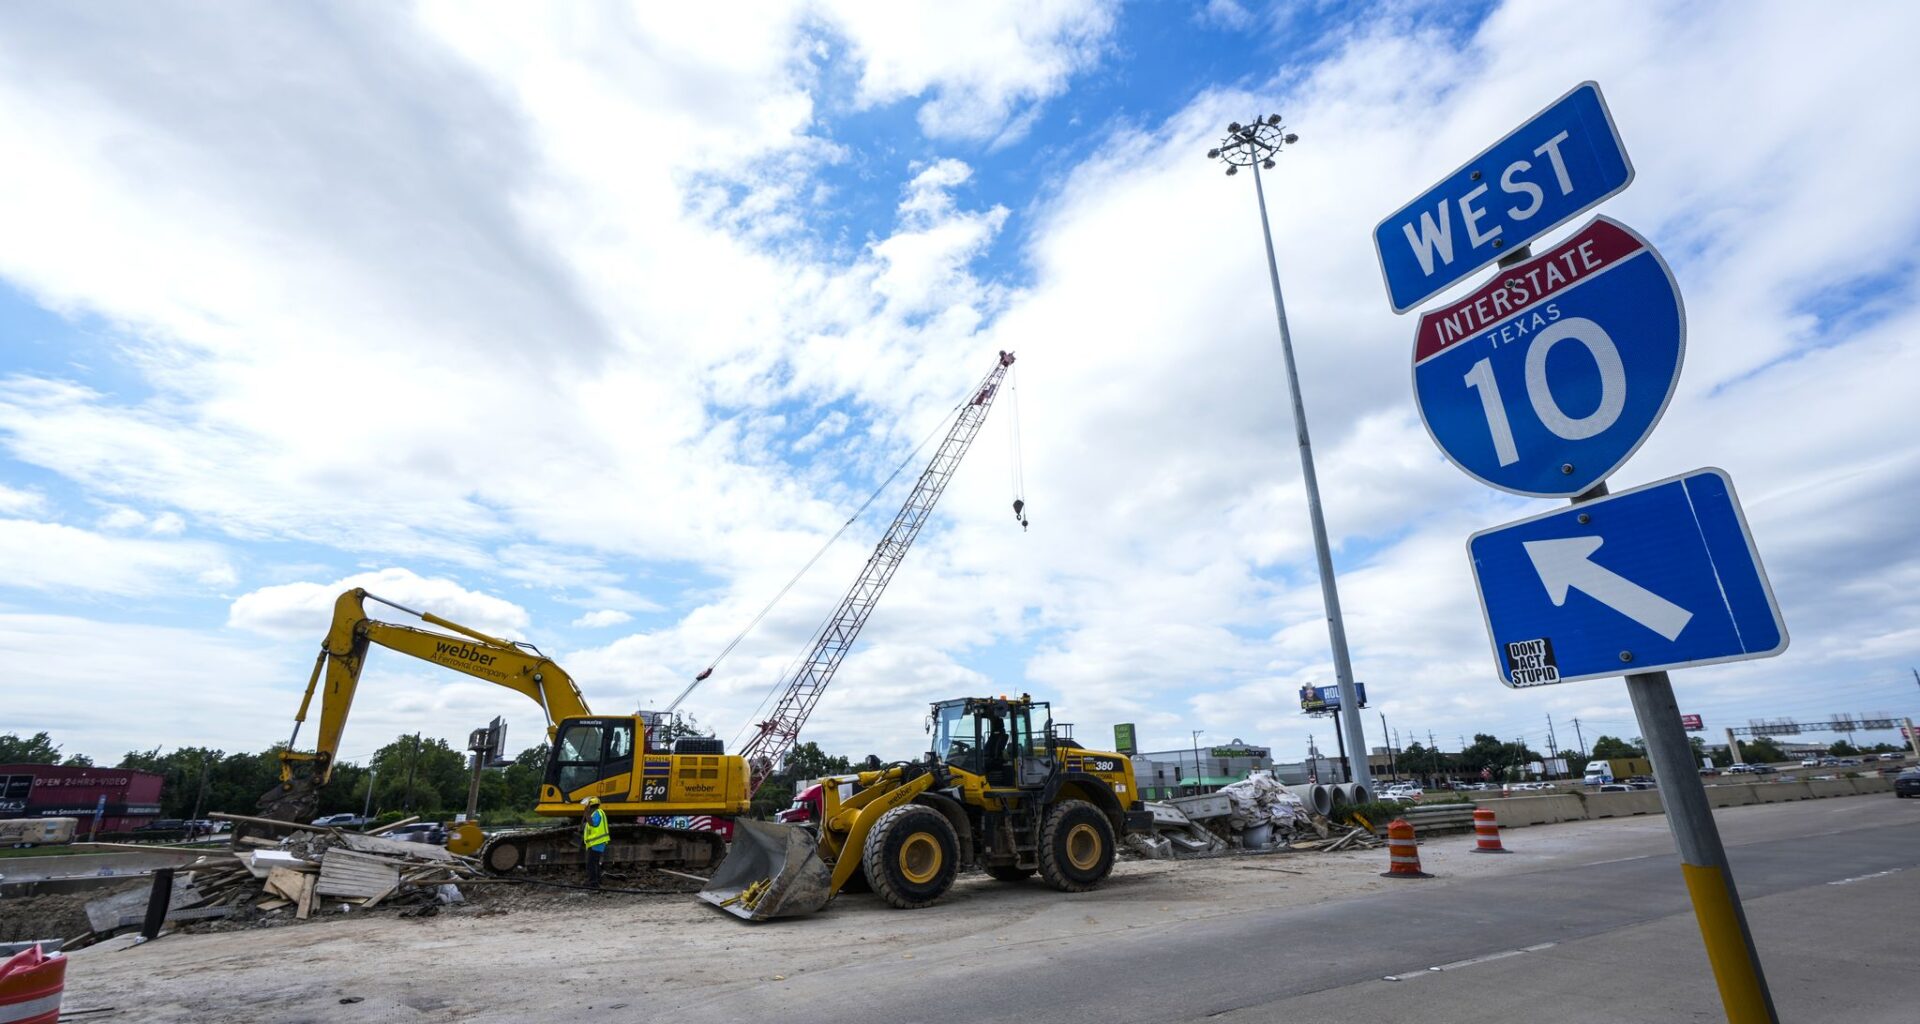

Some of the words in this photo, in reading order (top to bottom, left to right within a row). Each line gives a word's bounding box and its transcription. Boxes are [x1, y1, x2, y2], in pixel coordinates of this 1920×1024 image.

[1402, 130, 1575, 277] WEST
[1435, 240, 1602, 345] INTERSTATE
[1487, 303, 1561, 349] TEXAS
[1463, 317, 1626, 468] 10
[436, 641, 496, 666] webber
[1510, 640, 1543, 657] DONT
[430, 652, 438, 661] A
[472, 664, 508, 680] company
[1519, 654, 1542, 670] ACT
[1512, 666, 1557, 685] STUPID
[1323, 687, 1340, 699] HOL
[1095, 761, 1114, 771] 380
[35, 777, 61, 786] OPEN
[645, 786, 665, 795] 210
[684, 783, 715, 792] webber
[888, 785, 912, 805] webber
